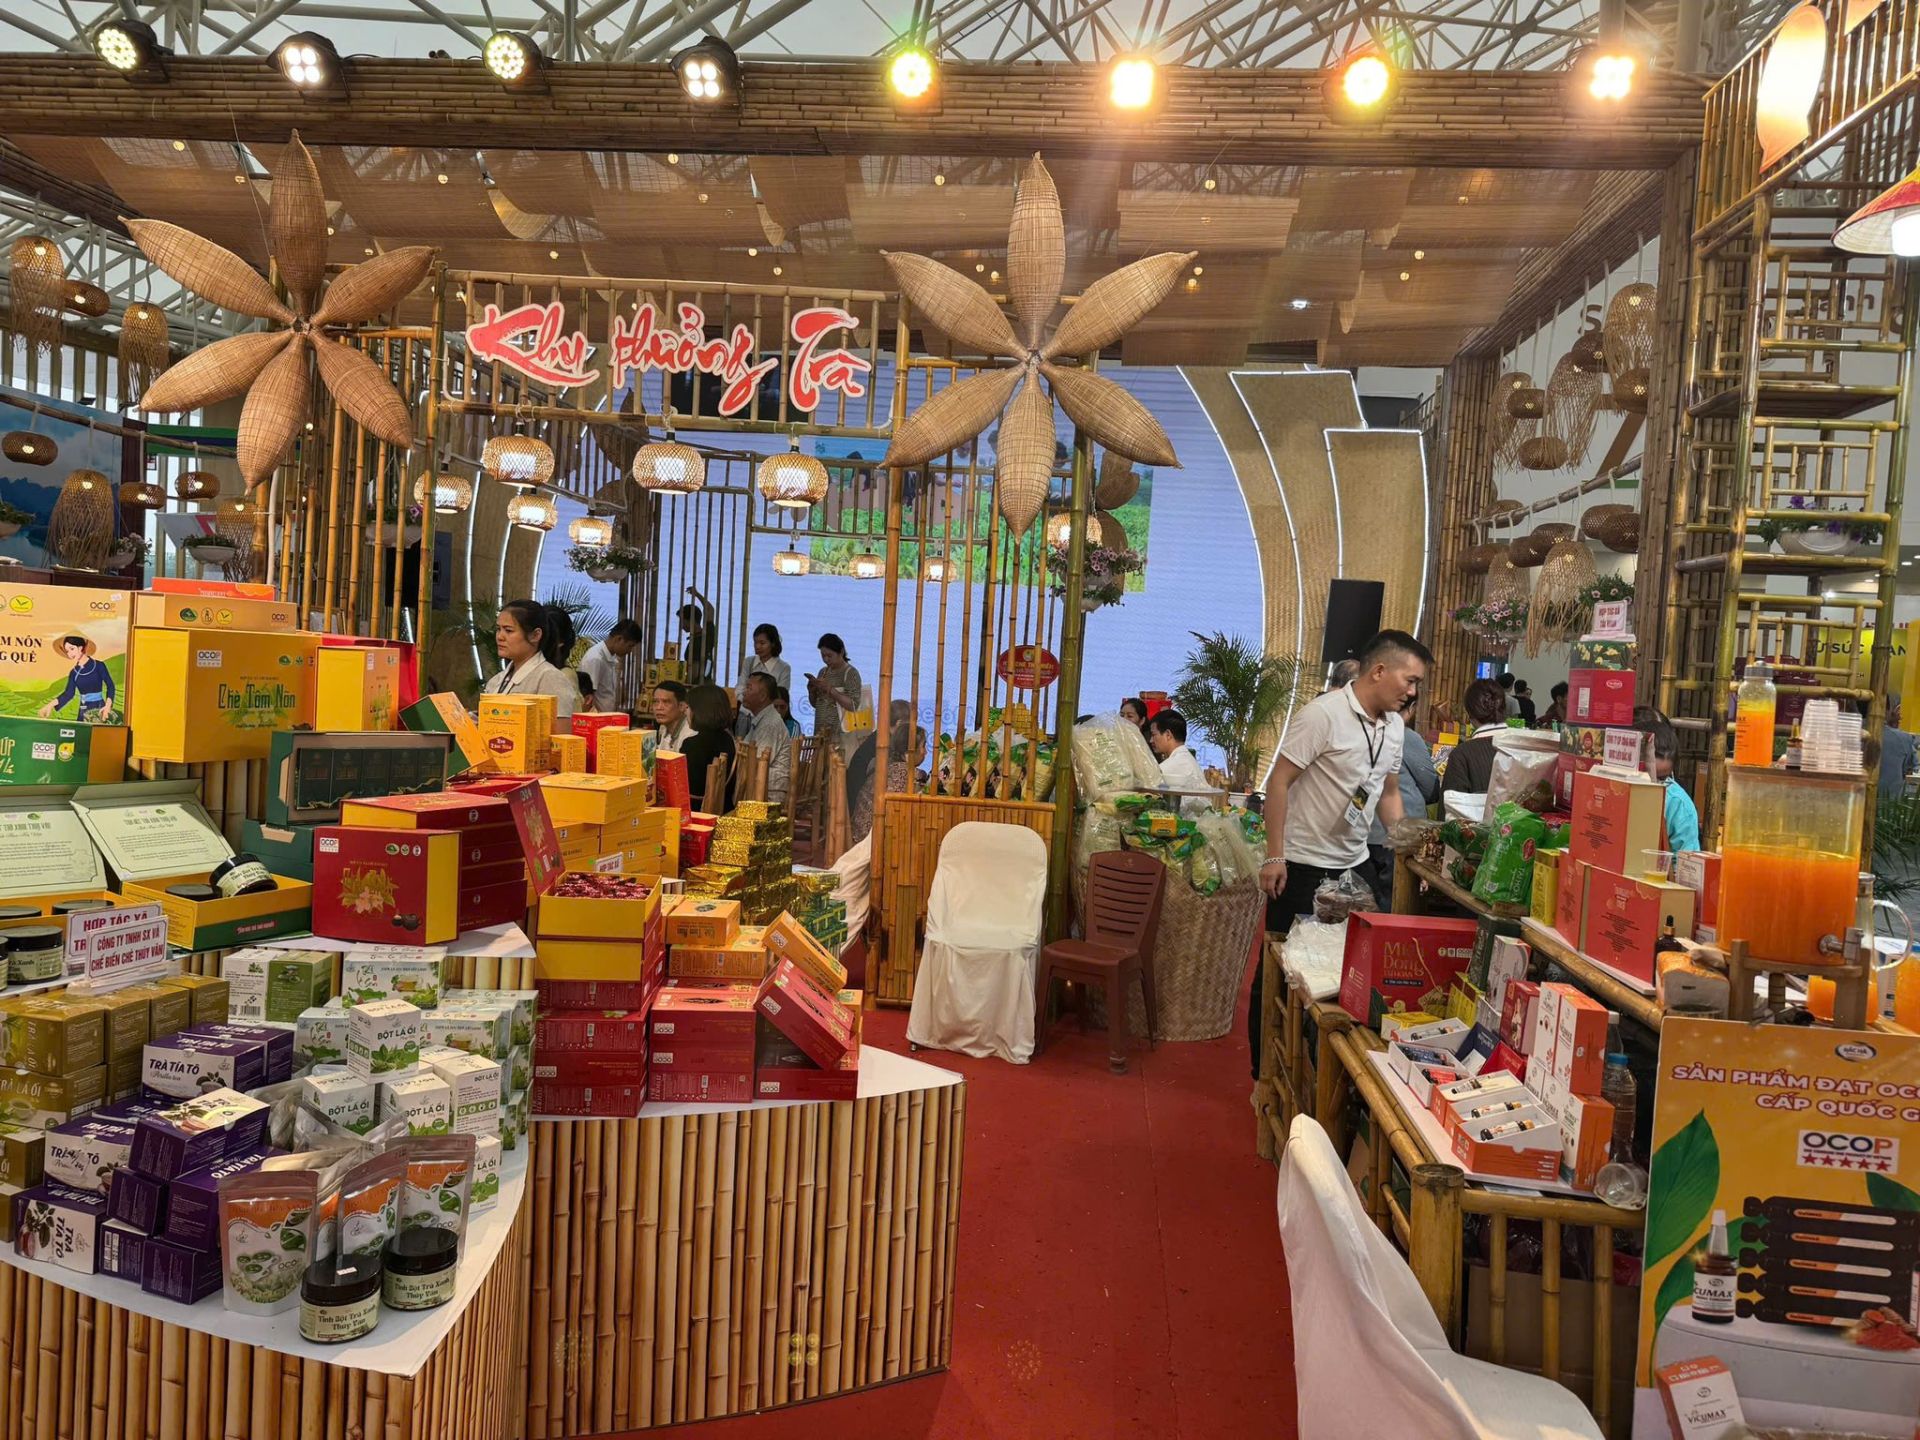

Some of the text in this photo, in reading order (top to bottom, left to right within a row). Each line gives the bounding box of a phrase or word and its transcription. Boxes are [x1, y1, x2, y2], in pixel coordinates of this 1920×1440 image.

[467, 301, 599, 388] Khu
[198, 651, 221, 659] OCOP
[84, 917, 107, 931] HỢP
[97, 936, 115, 951] CÔNG
[117, 936, 124, 948] TY
[125, 932, 142, 945] TNHH
[143, 929, 152, 941] SX
[377, 1024, 416, 1041] BỘT LÁ ỔI
[150, 1058, 200, 1075] TRÀ TÍA TÔ
[17, 1079, 28, 1094] LÁ
[31, 1081, 41, 1097] ỔI
[1673, 1063, 1725, 1082] SẢN
[1731, 1069, 1808, 1089] PHẨM
[1815, 1077, 1873, 1097] ĐẠT
[329, 1098, 369, 1116] BỘT LÁ ỔI
[423, 1104, 434, 1114] LÁ
[435, 1101, 445, 1112] ỔI
[1756, 1091, 1920, 1123] CẤP QUỐC G
[1803, 1131, 1893, 1154] OCOP
[478, 1161, 487, 1170] LÁ
[1694, 1288, 1733, 1298] CUMAX
[1687, 1409, 1727, 1424] VICUMAX
